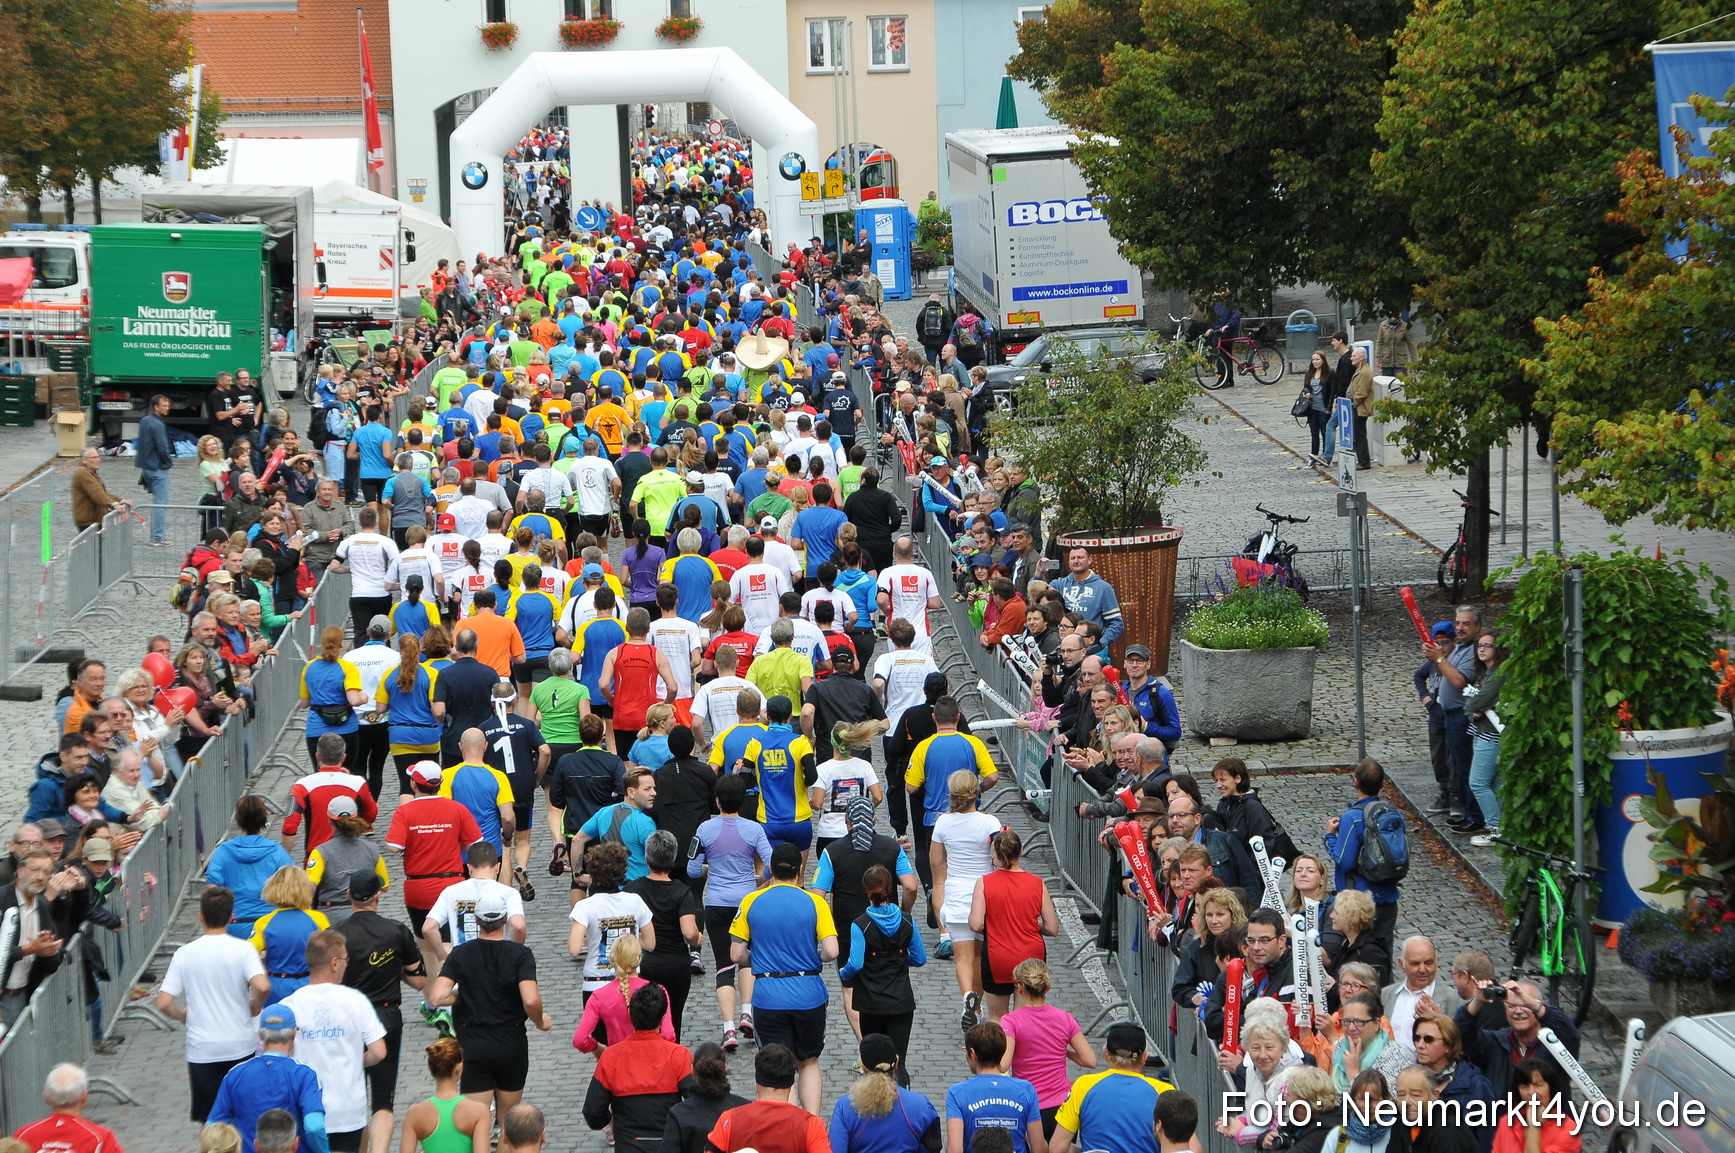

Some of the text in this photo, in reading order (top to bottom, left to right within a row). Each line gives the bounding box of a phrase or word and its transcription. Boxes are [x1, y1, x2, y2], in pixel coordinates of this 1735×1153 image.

[875, 215, 893, 227] DIXI
[1017, 233, 1057, 243] Entwicklung
[1018, 242, 1055, 251] Formenbau
[1018, 249, 1075, 260] Kunststofftechnik
[1019, 257, 1089, 269] Aluminium-Druckguss
[1020, 268, 1045, 277] Logistik
[1028, 284, 1113, 298] www.bockonline.de
[137, 306, 216, 320] Neumarkter
[122, 317, 231, 338] Lammsbräu
[161, 342, 213, 350] ÖKOLOGISCHE
[144, 351, 210, 359] www.lammsbraeu.de
[1341, 404, 1349, 441] P
[493, 735, 516, 774] 1
[1297, 939, 1309, 1020] bmw-laufsport.de
[1226, 1028, 1234, 1047] Audi
[967, 1097, 1024, 1113] funrunners
